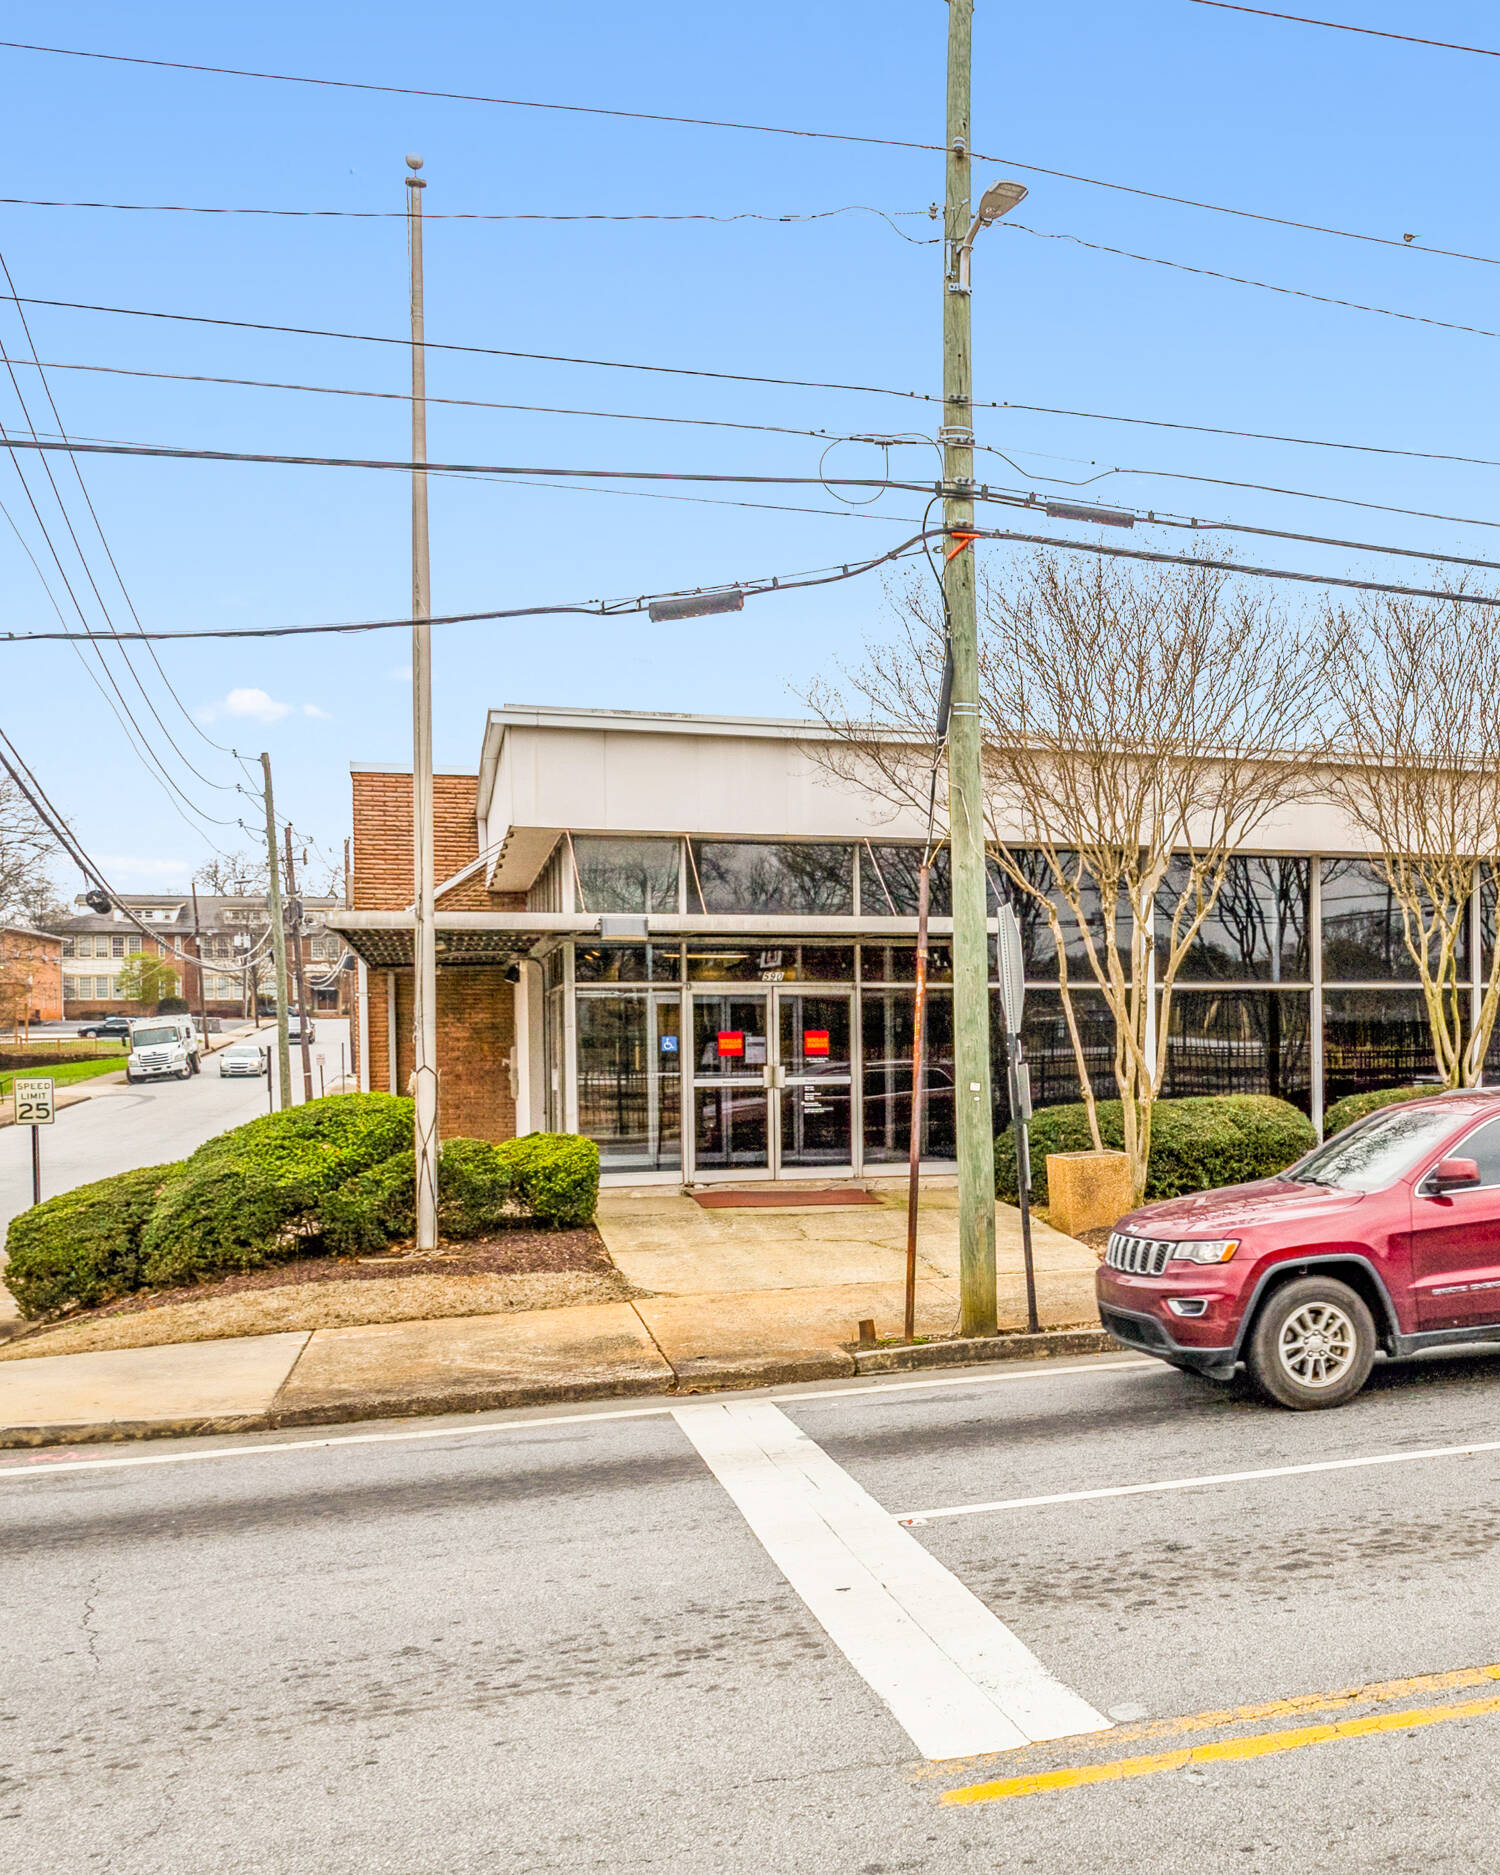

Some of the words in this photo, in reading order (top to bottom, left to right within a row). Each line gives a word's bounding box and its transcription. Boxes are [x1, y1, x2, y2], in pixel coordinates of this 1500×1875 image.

[17, 1082, 51, 1090] SPEED
[21, 1092, 47, 1100] LIMIT
[18, 1103, 50, 1119] 25
